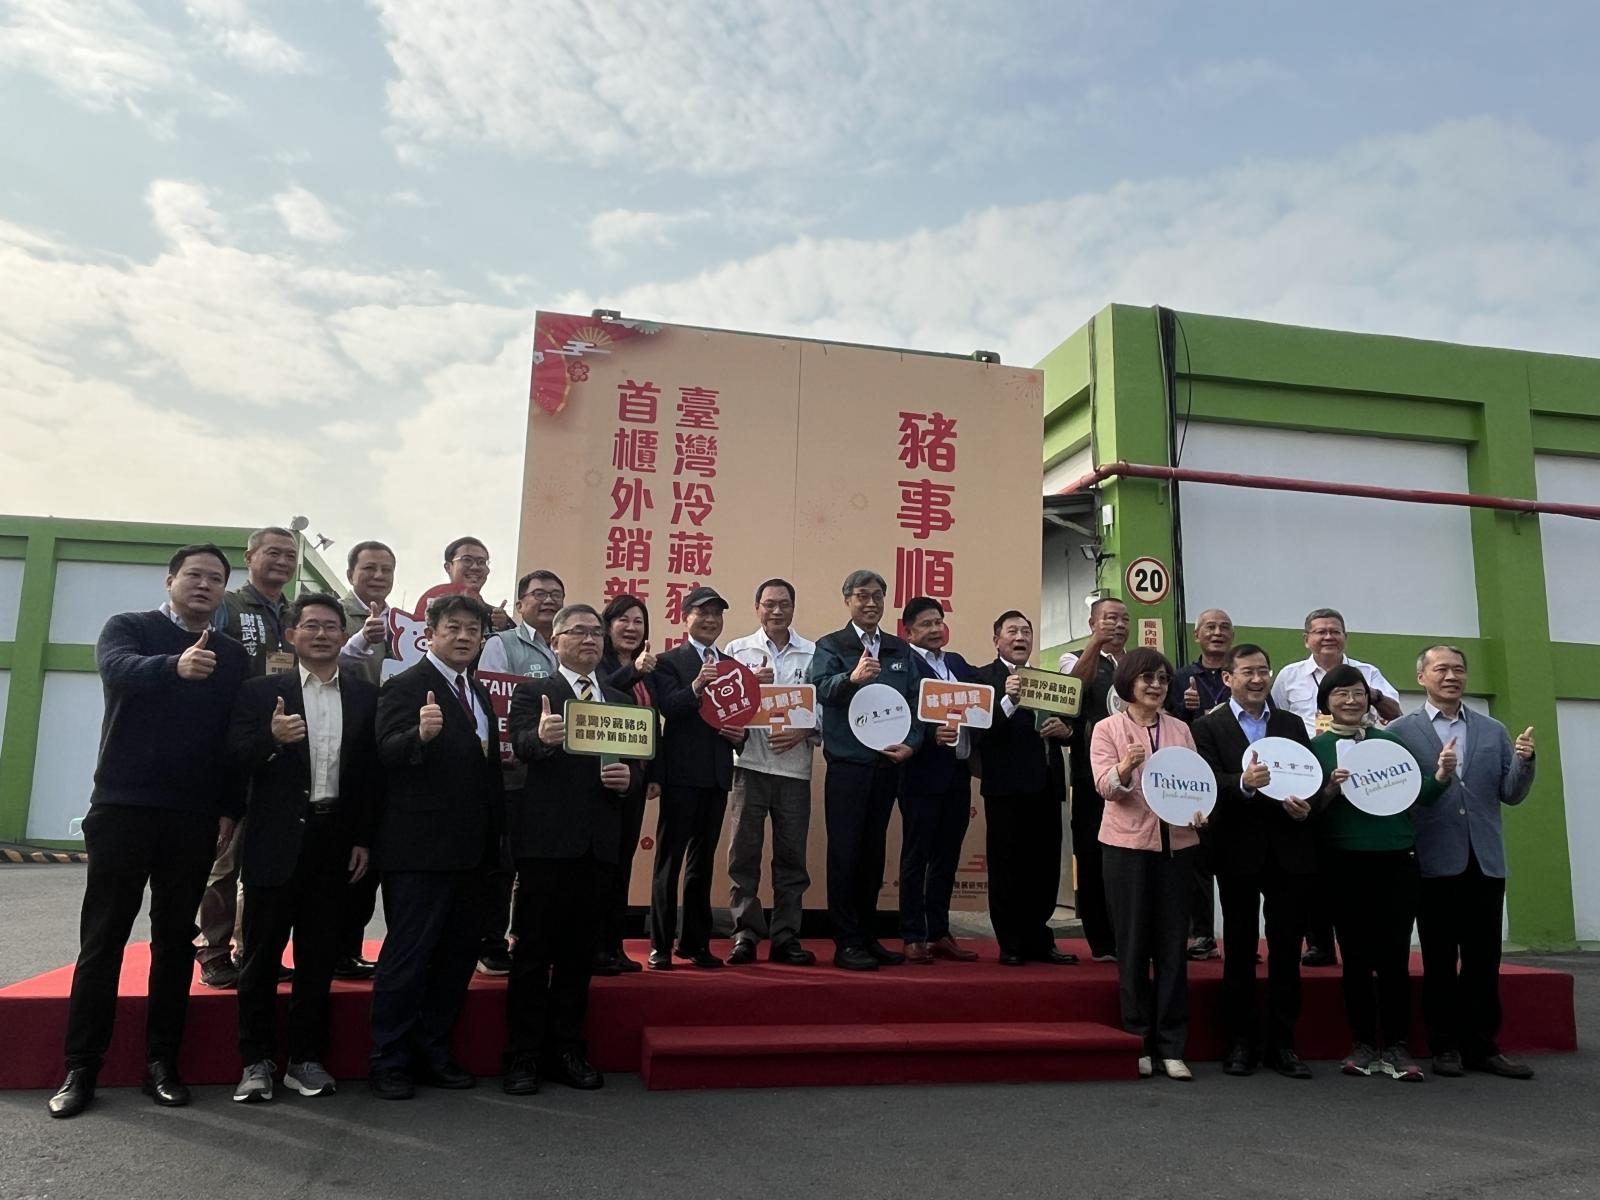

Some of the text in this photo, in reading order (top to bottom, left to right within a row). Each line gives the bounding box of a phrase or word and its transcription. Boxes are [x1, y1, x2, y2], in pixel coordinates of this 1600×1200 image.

[894, 411, 958, 648] 豬事順
[1135, 568, 1163, 593] 20
[1150, 771, 1211, 793] Taiwan
[1350, 761, 1413, 789] Taiwan
